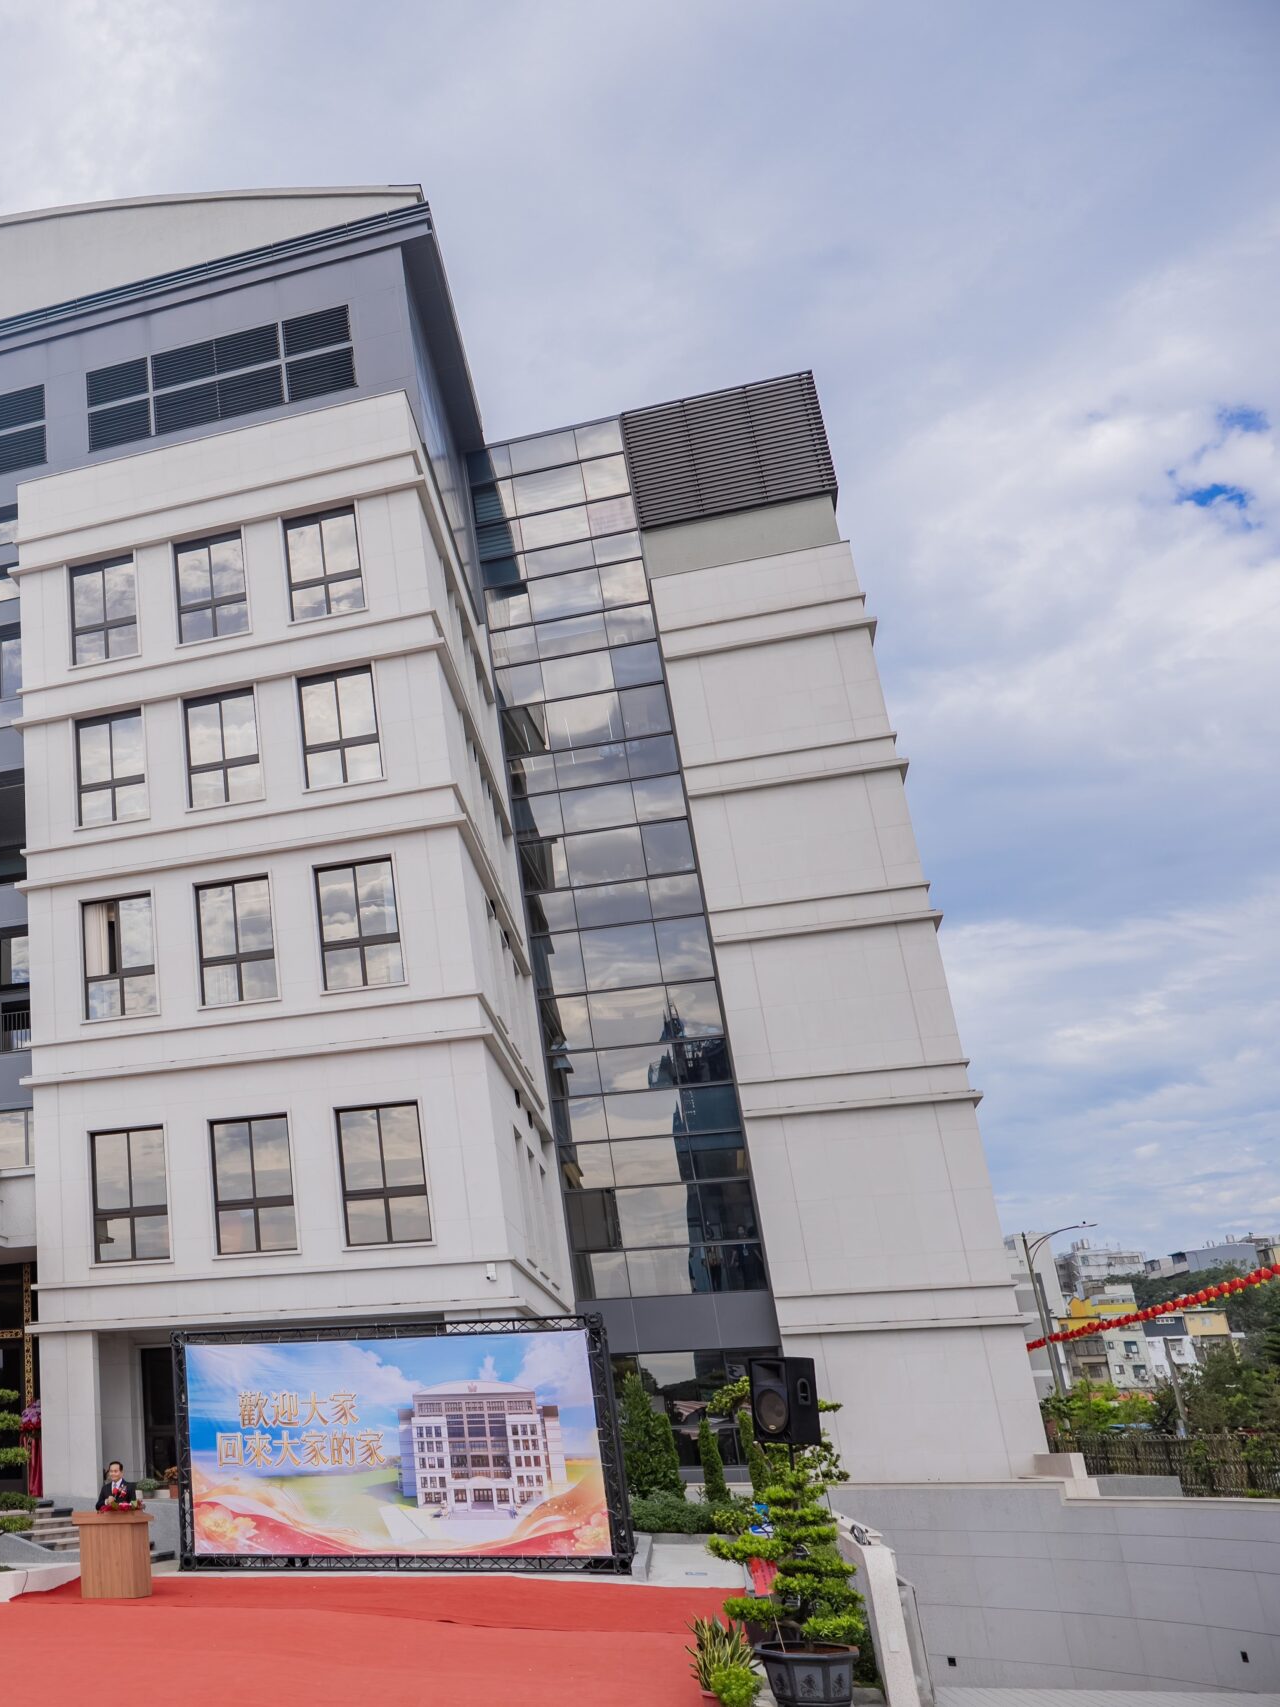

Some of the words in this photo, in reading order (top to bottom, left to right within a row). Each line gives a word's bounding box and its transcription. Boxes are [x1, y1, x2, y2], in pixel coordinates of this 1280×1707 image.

[238, 1390, 360, 1428] 歡迎大家
[216, 1429, 386, 1467] 回來大家的家
